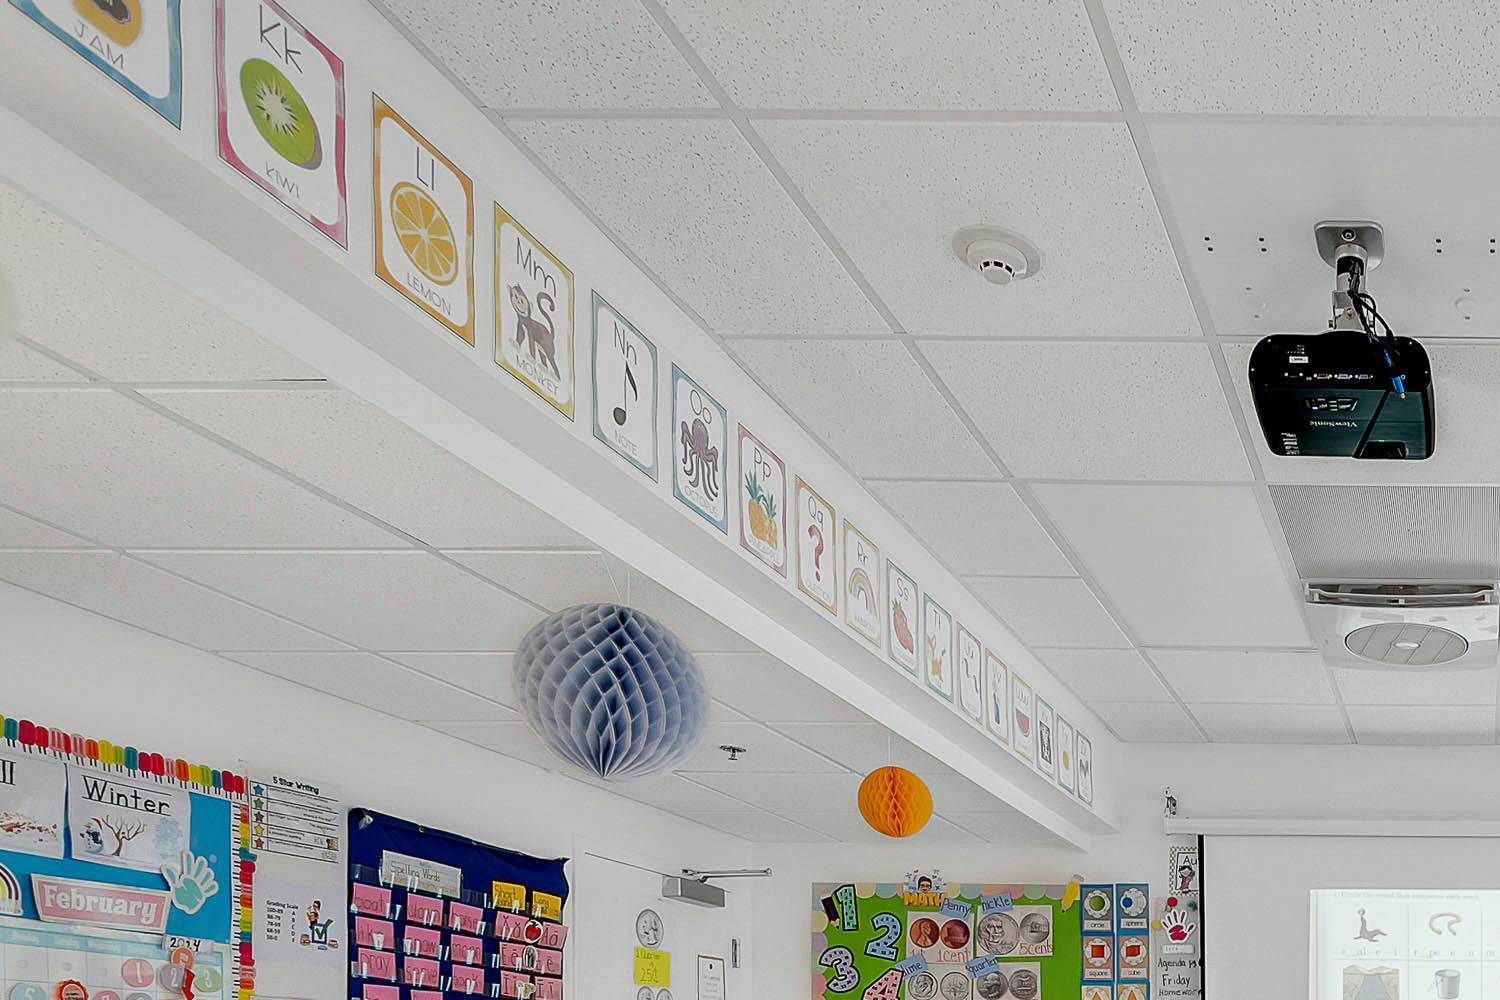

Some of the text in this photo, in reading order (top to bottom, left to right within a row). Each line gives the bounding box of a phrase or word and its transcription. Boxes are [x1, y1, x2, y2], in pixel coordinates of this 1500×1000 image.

[73, 20, 127, 70] JAM
[264, 161, 300, 200] KIWI
[516, 236, 558, 299] Mm
[405, 272, 453, 317] LEMON
[613, 320, 638, 366] Nn
[515, 353, 561, 397] MONKEY
[614, 427, 639, 457] NOTE
[753, 446, 772, 482] Pp
[807, 495, 825, 532] Qq
[82, 775, 171, 816] Winter
[272, 776, 278, 784] 5
[278, 777, 294, 788] Star
[390, 862, 441, 884] Spelling Words
[43, 884, 159, 925] February
[941, 894, 1011, 919] Penny nickle
[168, 936, 202, 952] 2024
[136, 960, 143, 984] 1
[1157, 957, 1187, 972] Agenda
[1161, 973, 1191, 988] Friday
